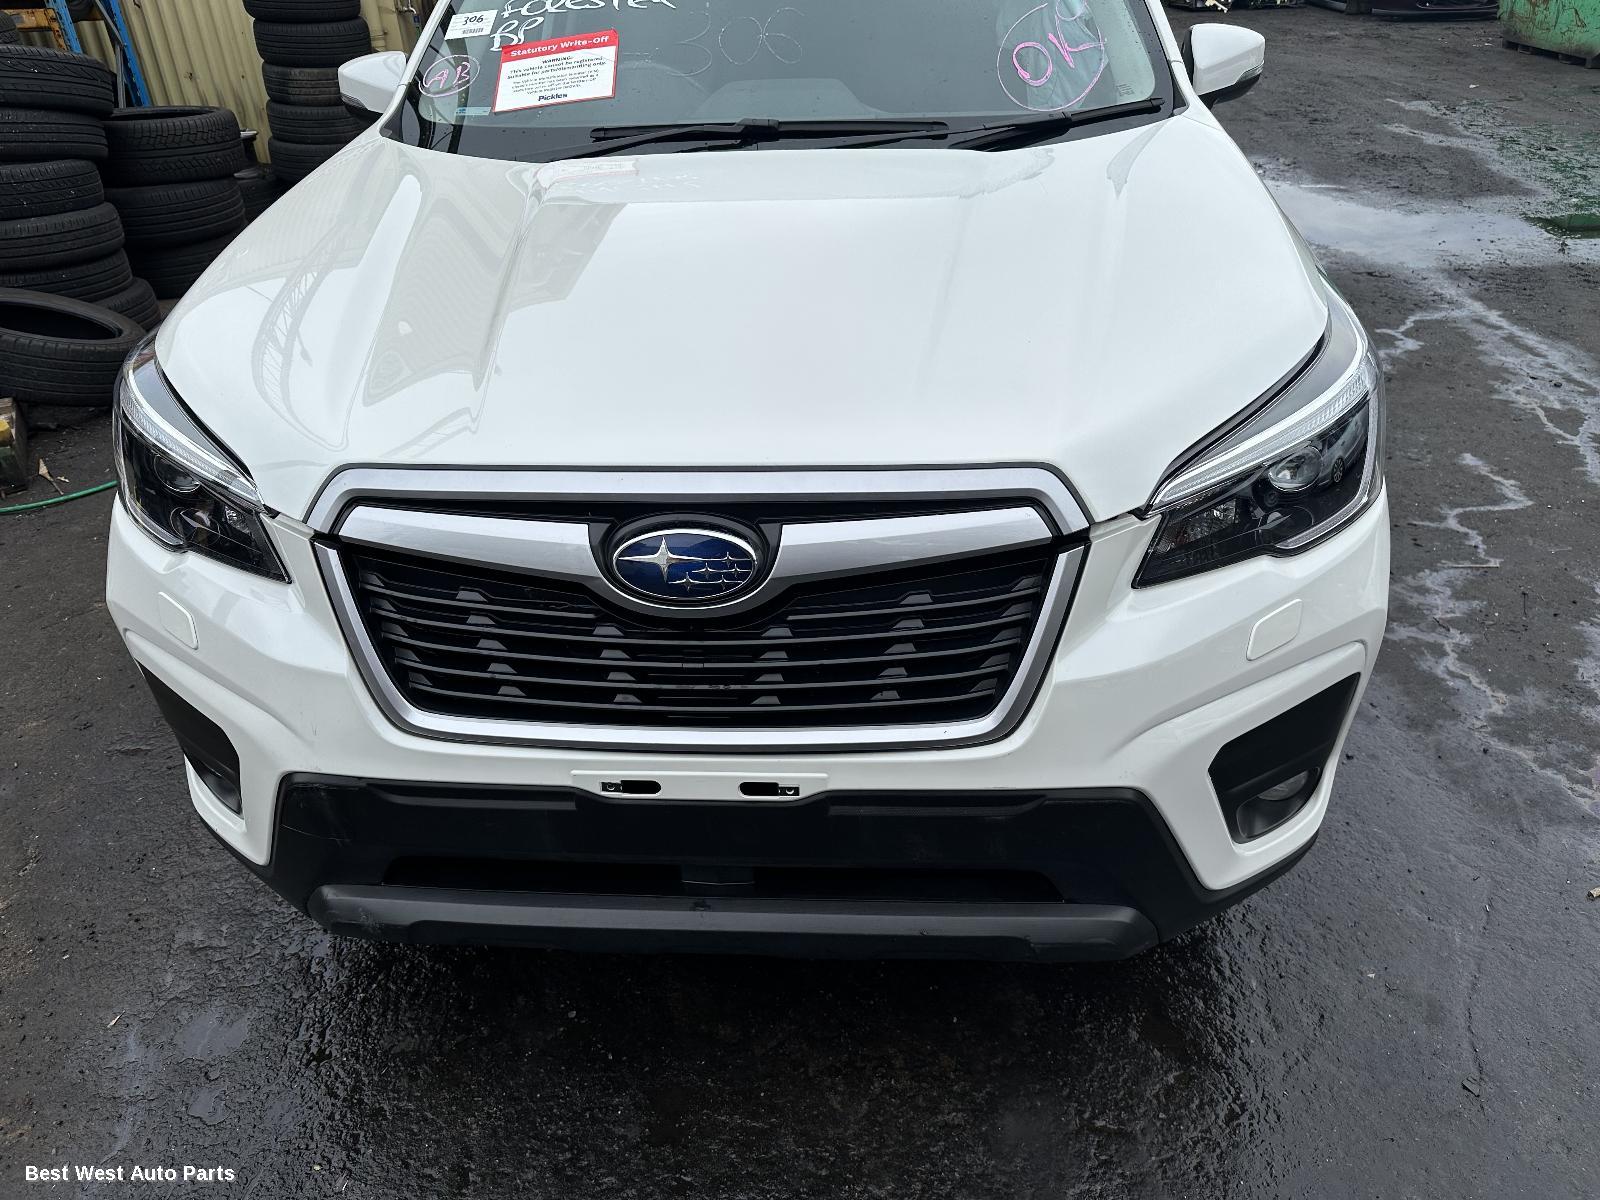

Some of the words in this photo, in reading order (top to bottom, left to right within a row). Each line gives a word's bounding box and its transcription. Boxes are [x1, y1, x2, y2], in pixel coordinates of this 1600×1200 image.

[462, 14, 484, 25] 306
[511, 44, 558, 57] Statutory
[560, 35, 609, 49] Write-Off
[538, 92, 568, 101] Pickles
